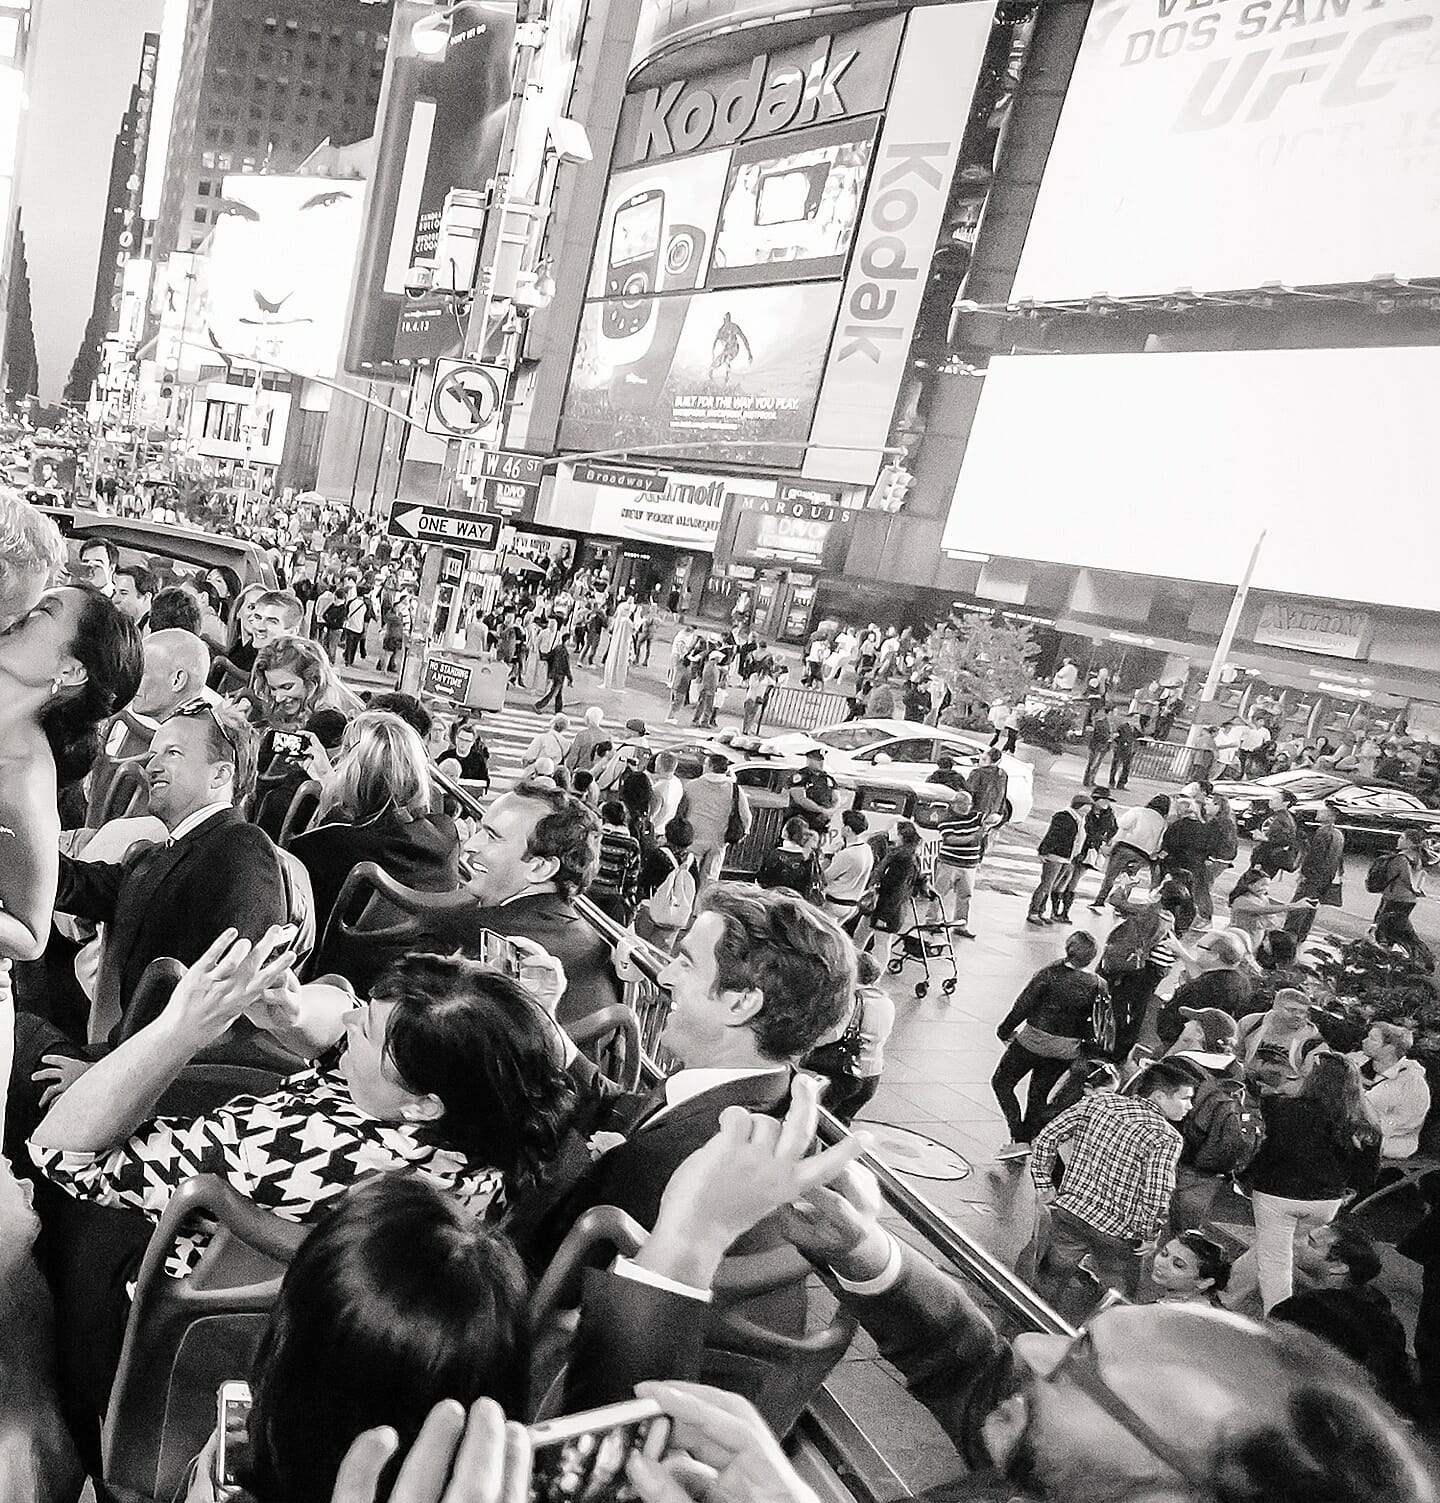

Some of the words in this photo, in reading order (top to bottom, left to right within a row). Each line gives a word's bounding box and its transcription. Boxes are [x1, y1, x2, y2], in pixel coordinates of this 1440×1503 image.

[1120, 12, 1222, 68] DOS
[1170, 14, 1434, 135] UFC
[634, 33, 861, 163] Kodak
[836, 141, 952, 365] Kodak
[733, 396, 754, 409] WAY
[754, 397, 776, 410] YOU
[486, 454, 500, 475] W
[502, 458, 521, 478] 46
[526, 459, 541, 471] ST
[586, 469, 653, 489] Broadway
[621, 508, 644, 521] NEW
[646, 511, 674, 525] YORK
[676, 515, 721, 532] MARQU
[742, 497, 851, 522] MARQUIS
[419, 516, 449, 534] ONE
[457, 521, 489, 539] WAY
[430, 661, 439, 671] NO
[439, 663, 470, 680] STANDING
[431, 671, 463, 688] ANYTIME
